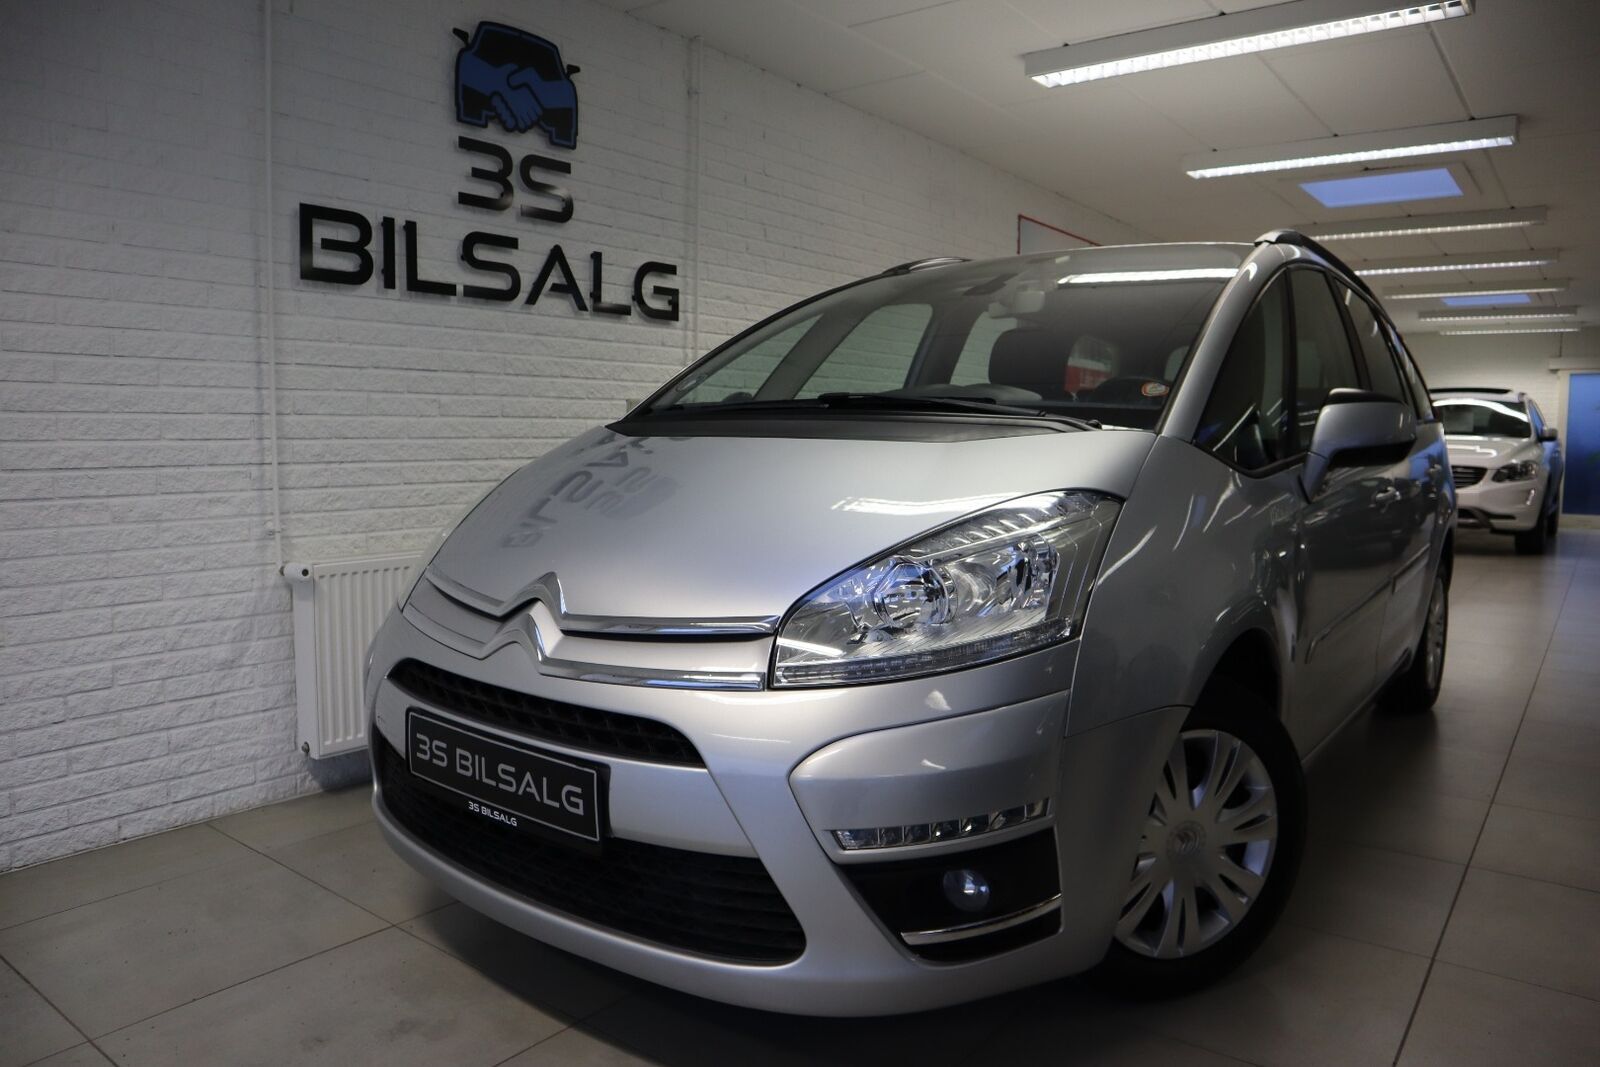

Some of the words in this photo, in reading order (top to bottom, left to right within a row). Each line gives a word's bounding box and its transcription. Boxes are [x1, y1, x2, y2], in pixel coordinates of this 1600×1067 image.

[457, 135, 575, 224] 3S
[299, 202, 680, 322] BILSALG
[416, 732, 448, 768] 3S
[455, 747, 585, 816] BILSALG
[468, 801, 480, 813] 3S
[481, 806, 518, 827] BILSALG
